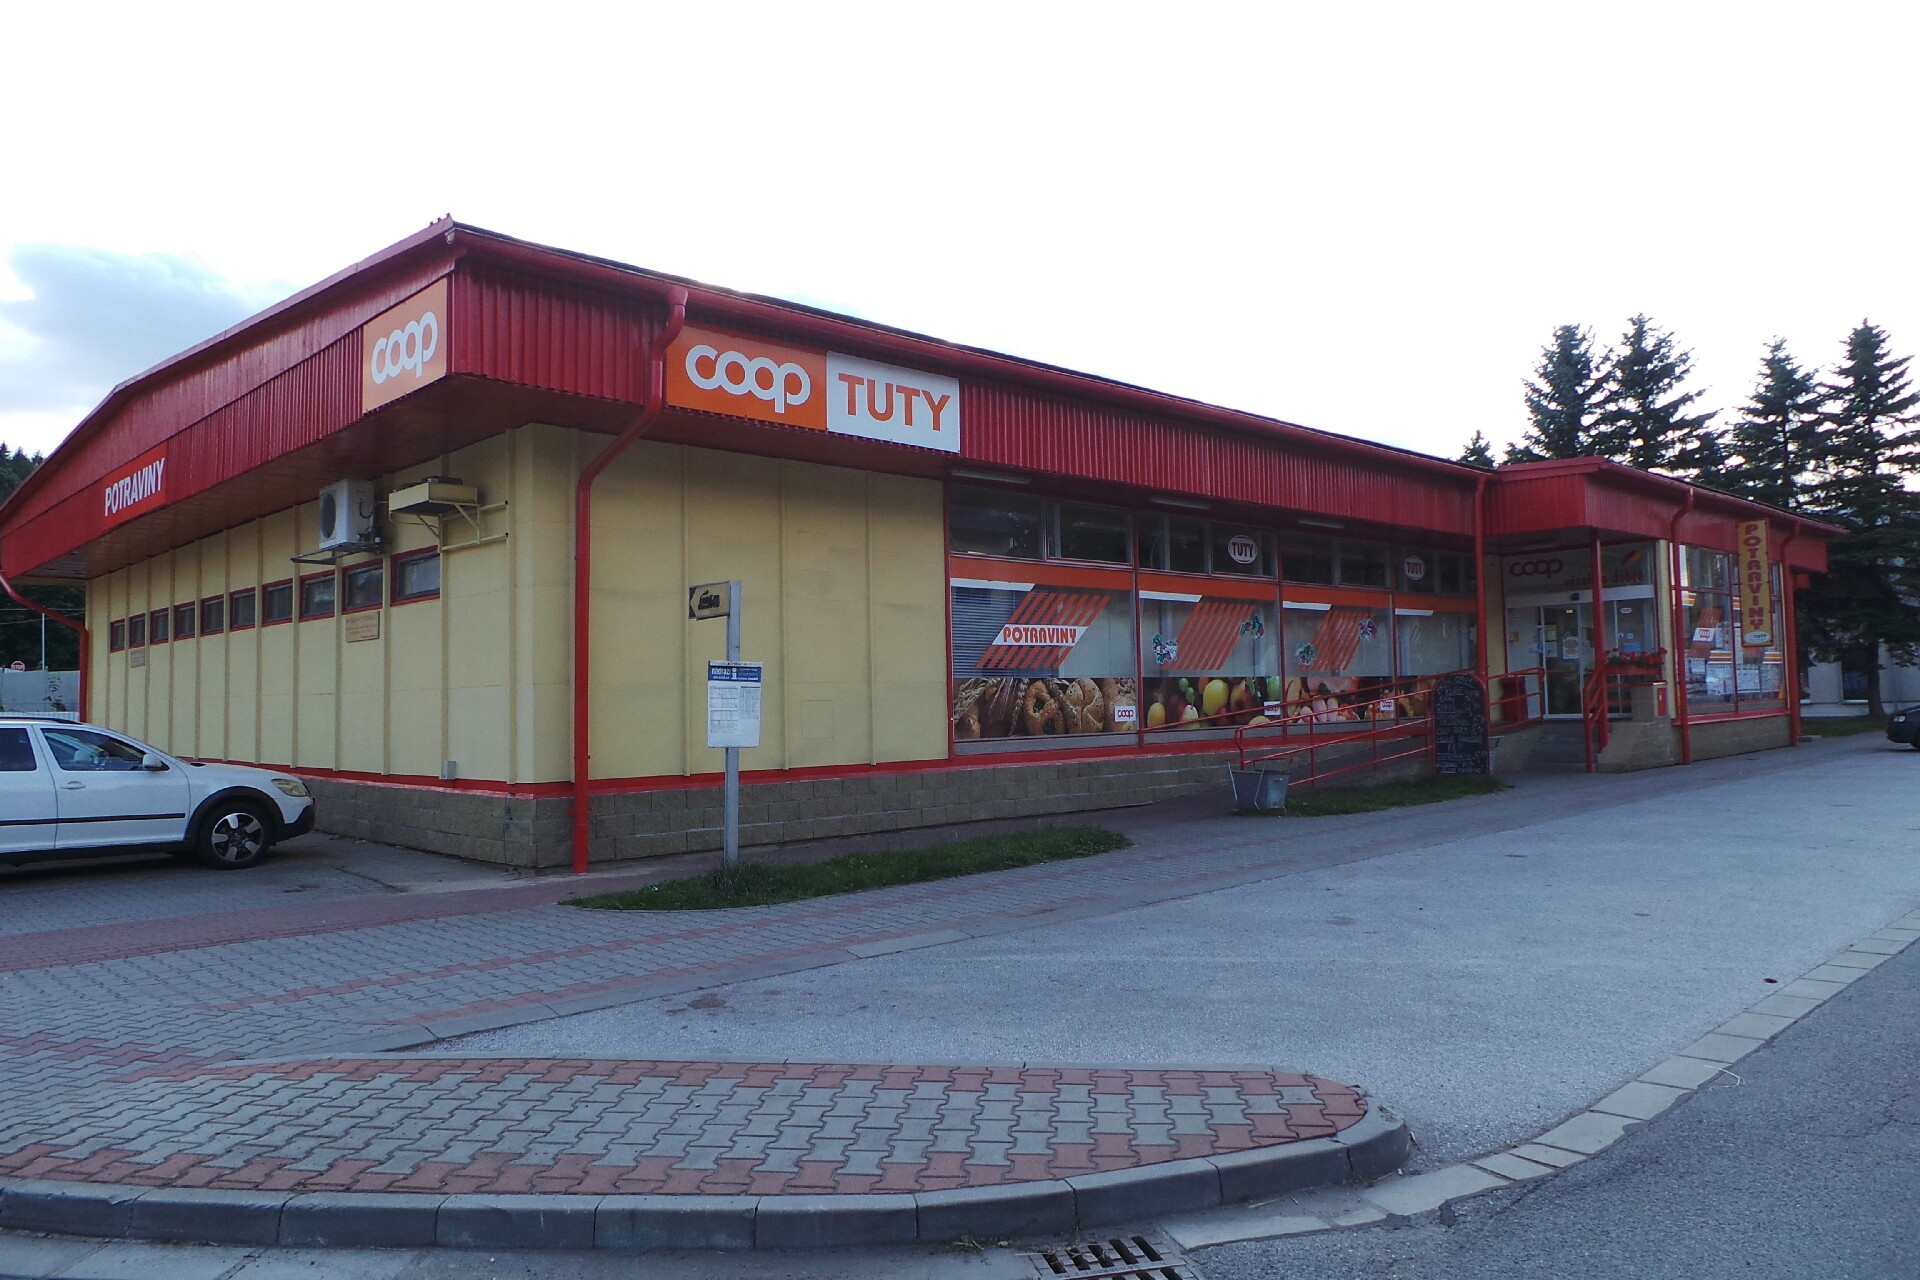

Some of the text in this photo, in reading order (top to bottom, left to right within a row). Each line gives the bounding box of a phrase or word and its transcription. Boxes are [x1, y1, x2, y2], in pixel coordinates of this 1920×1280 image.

[371, 311, 438, 385] coop
[685, 344, 951, 431] coop TUTY
[104, 457, 165, 517] POTRAVINY
[1231, 541, 1254, 558] TUTY
[1406, 562, 1424, 575] TUTY
[1509, 558, 1563, 578] coop
[1743, 523, 1764, 630] POTRAVINY
[1003, 626, 1077, 643] POTRAVINY
[1117, 709, 1134, 720] coop
